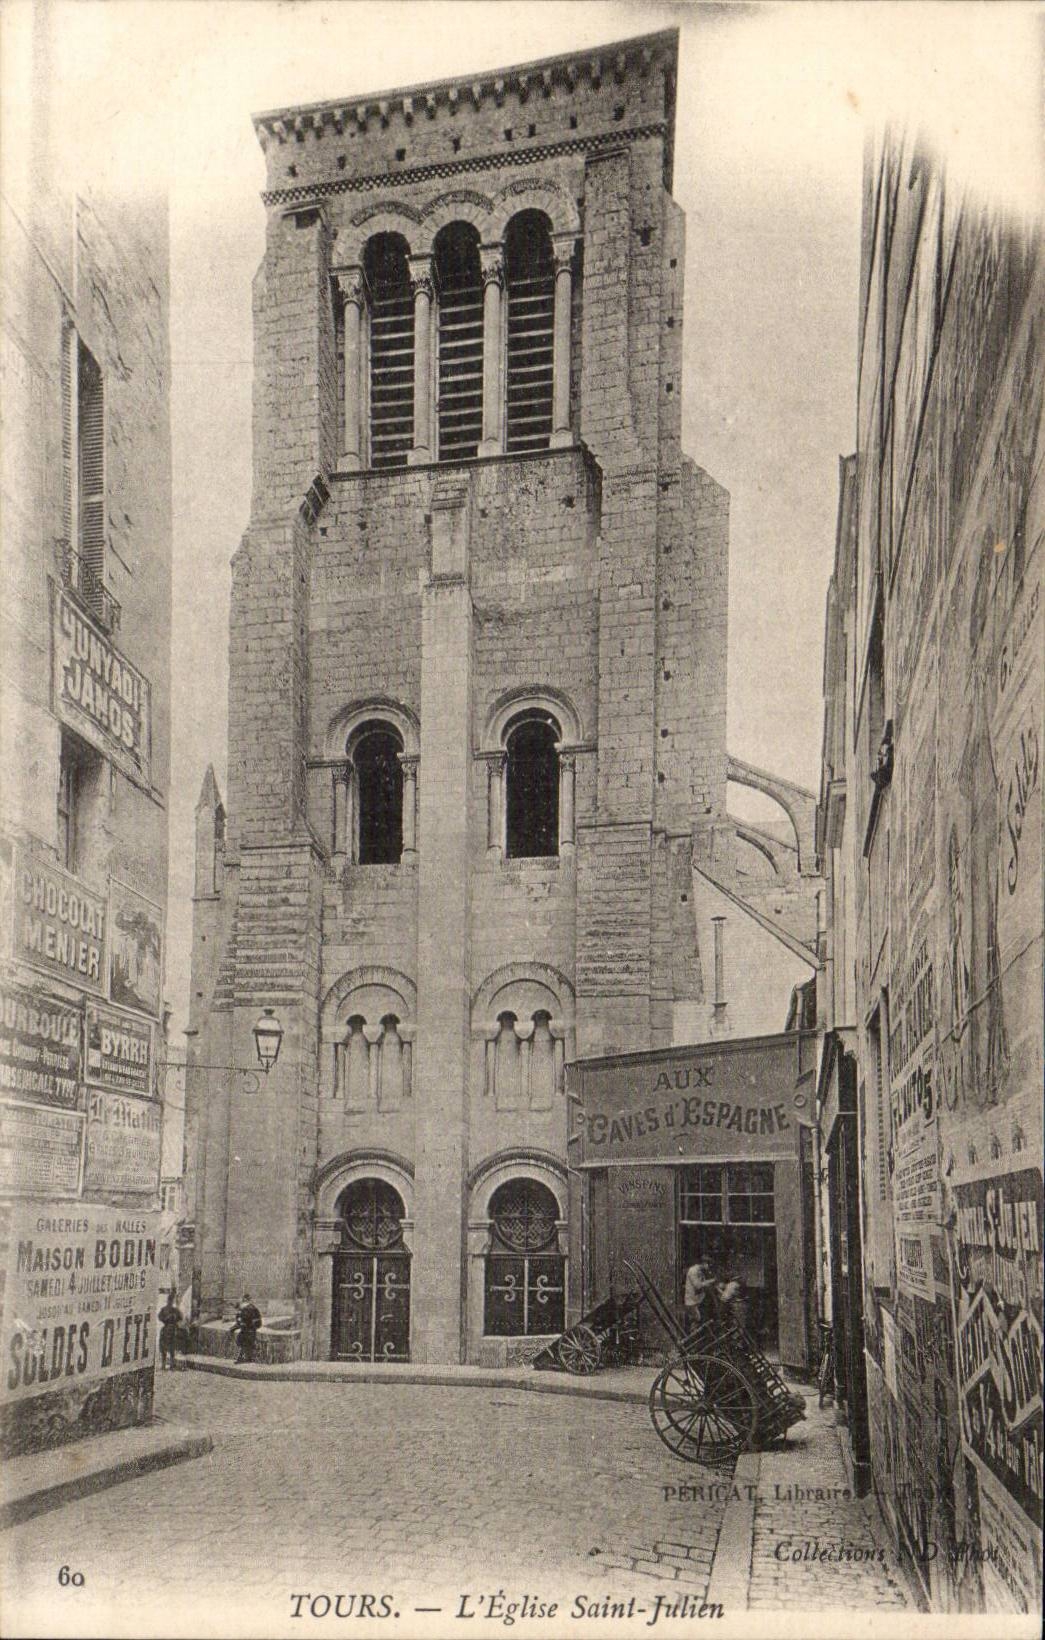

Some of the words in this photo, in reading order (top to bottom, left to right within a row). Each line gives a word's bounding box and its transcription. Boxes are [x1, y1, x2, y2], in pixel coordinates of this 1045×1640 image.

[22, 868, 105, 942] CHOCOLAT
[23, 912, 101, 982] MENIER
[101, 1027, 149, 1065] BYRRH
[653, 1066, 714, 1091] AUX
[587, 1111, 660, 1145] CAVES
[36, 1218, 89, 1233] GALERIES
[115, 1220, 146, 1233] HALLES
[17, 1240, 85, 1273] MAISON
[94, 1239, 156, 1269] BODIN
[27, 1278, 65, 1298] SAMEDI
[69, 1272, 76, 1296] 4
[7, 1320, 90, 1390] SOLDES
